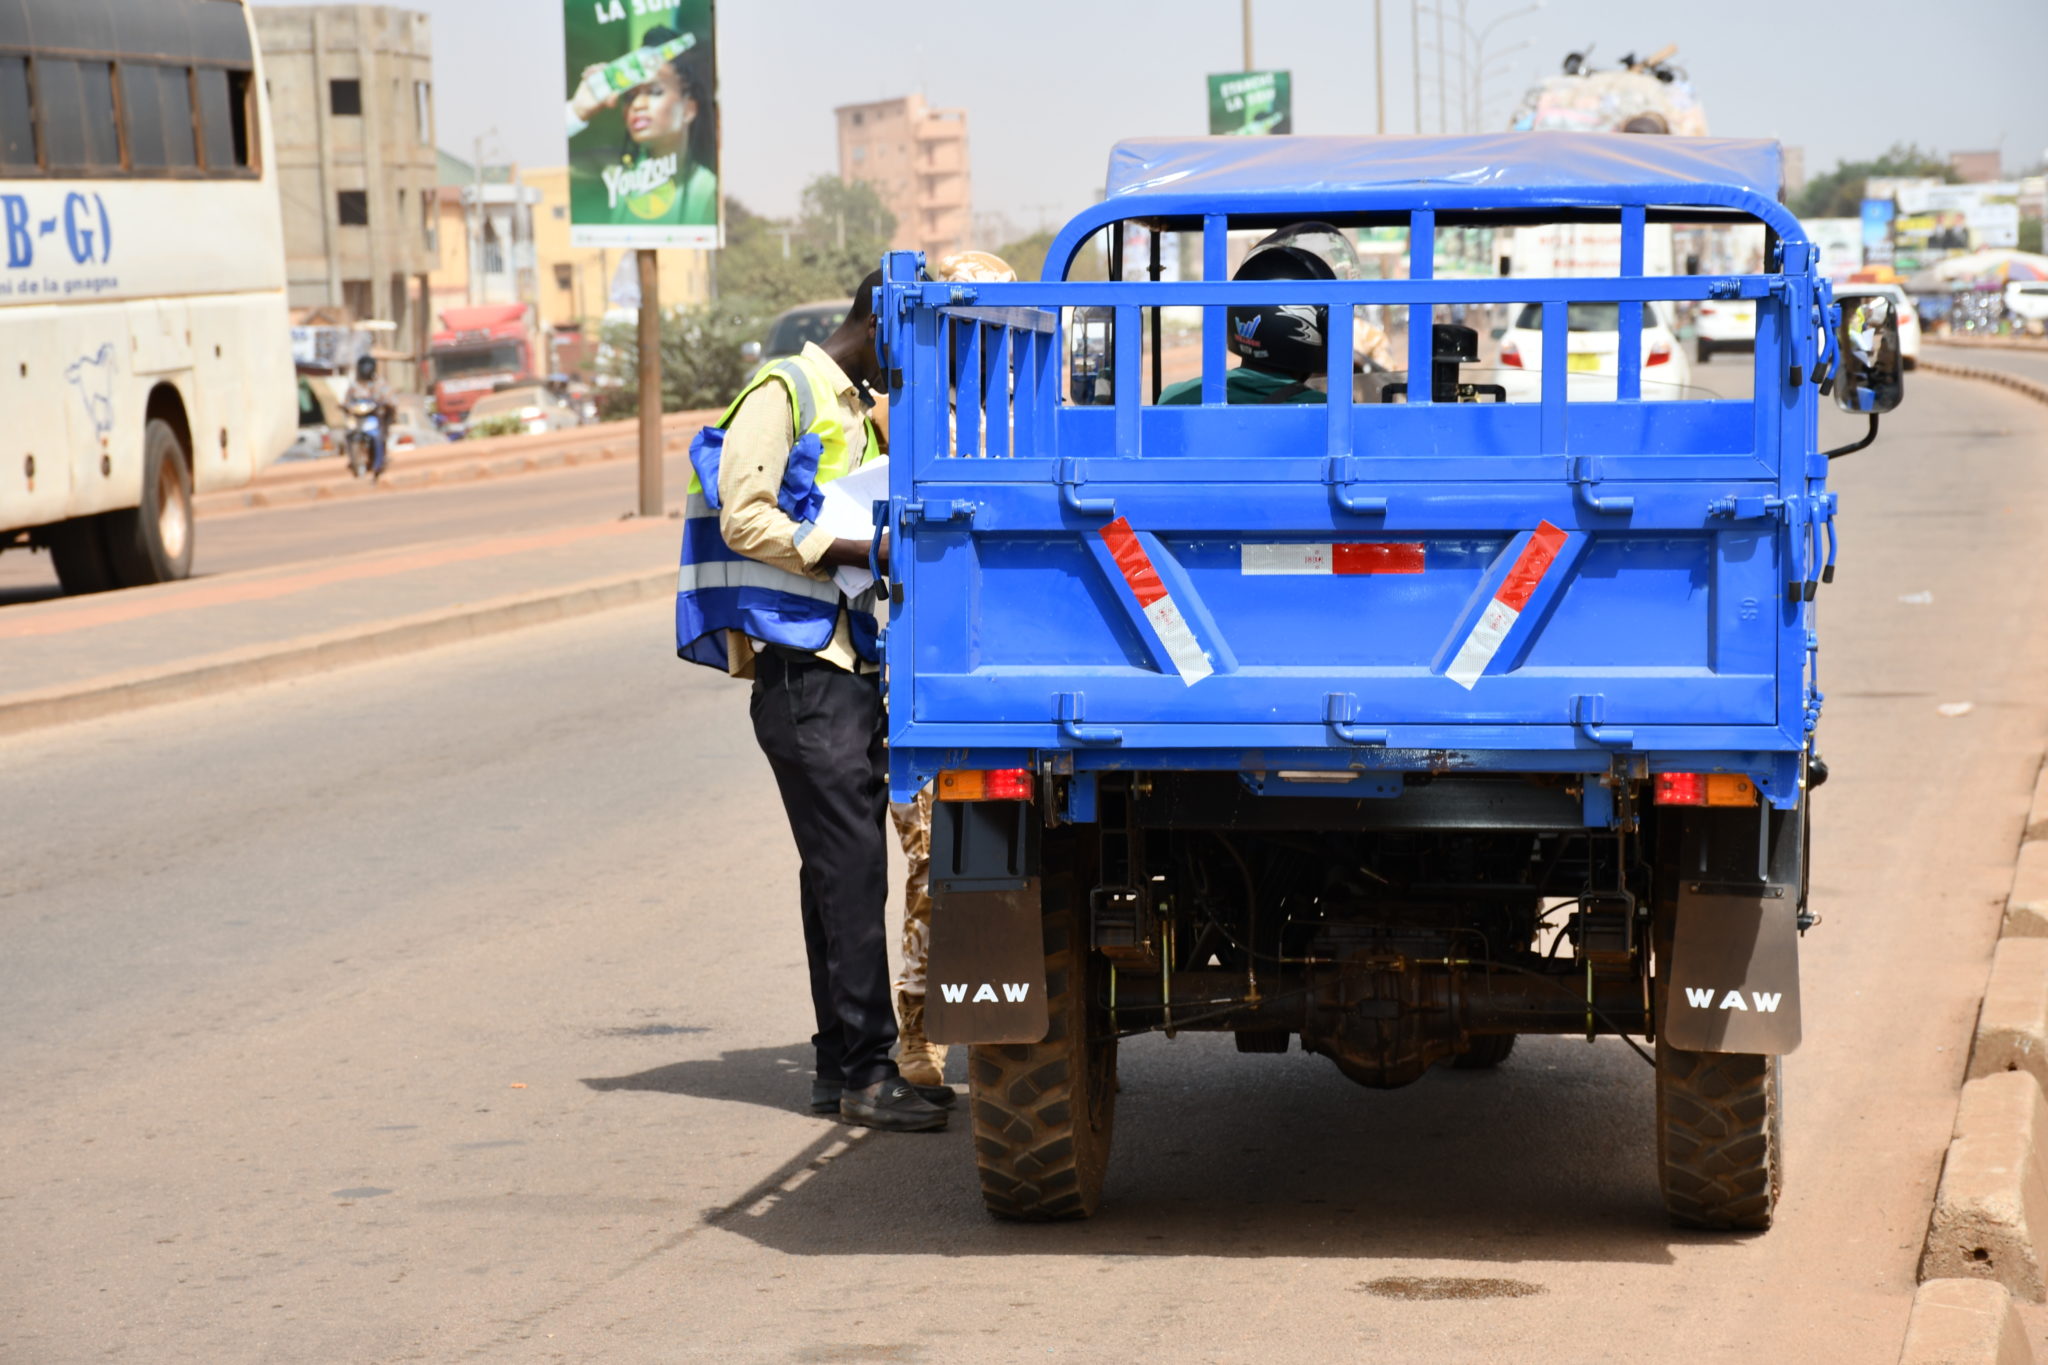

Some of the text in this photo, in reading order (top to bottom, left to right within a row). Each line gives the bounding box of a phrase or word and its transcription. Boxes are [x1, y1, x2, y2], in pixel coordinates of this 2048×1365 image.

[594, 0, 627, 24] LA
[601, 152, 678, 209] YouZou
[17, 279, 38, 293] de
[42, 278, 59, 292] la
[940, 983, 1030, 1004] WAW
[1685, 987, 1782, 1013] WAW
